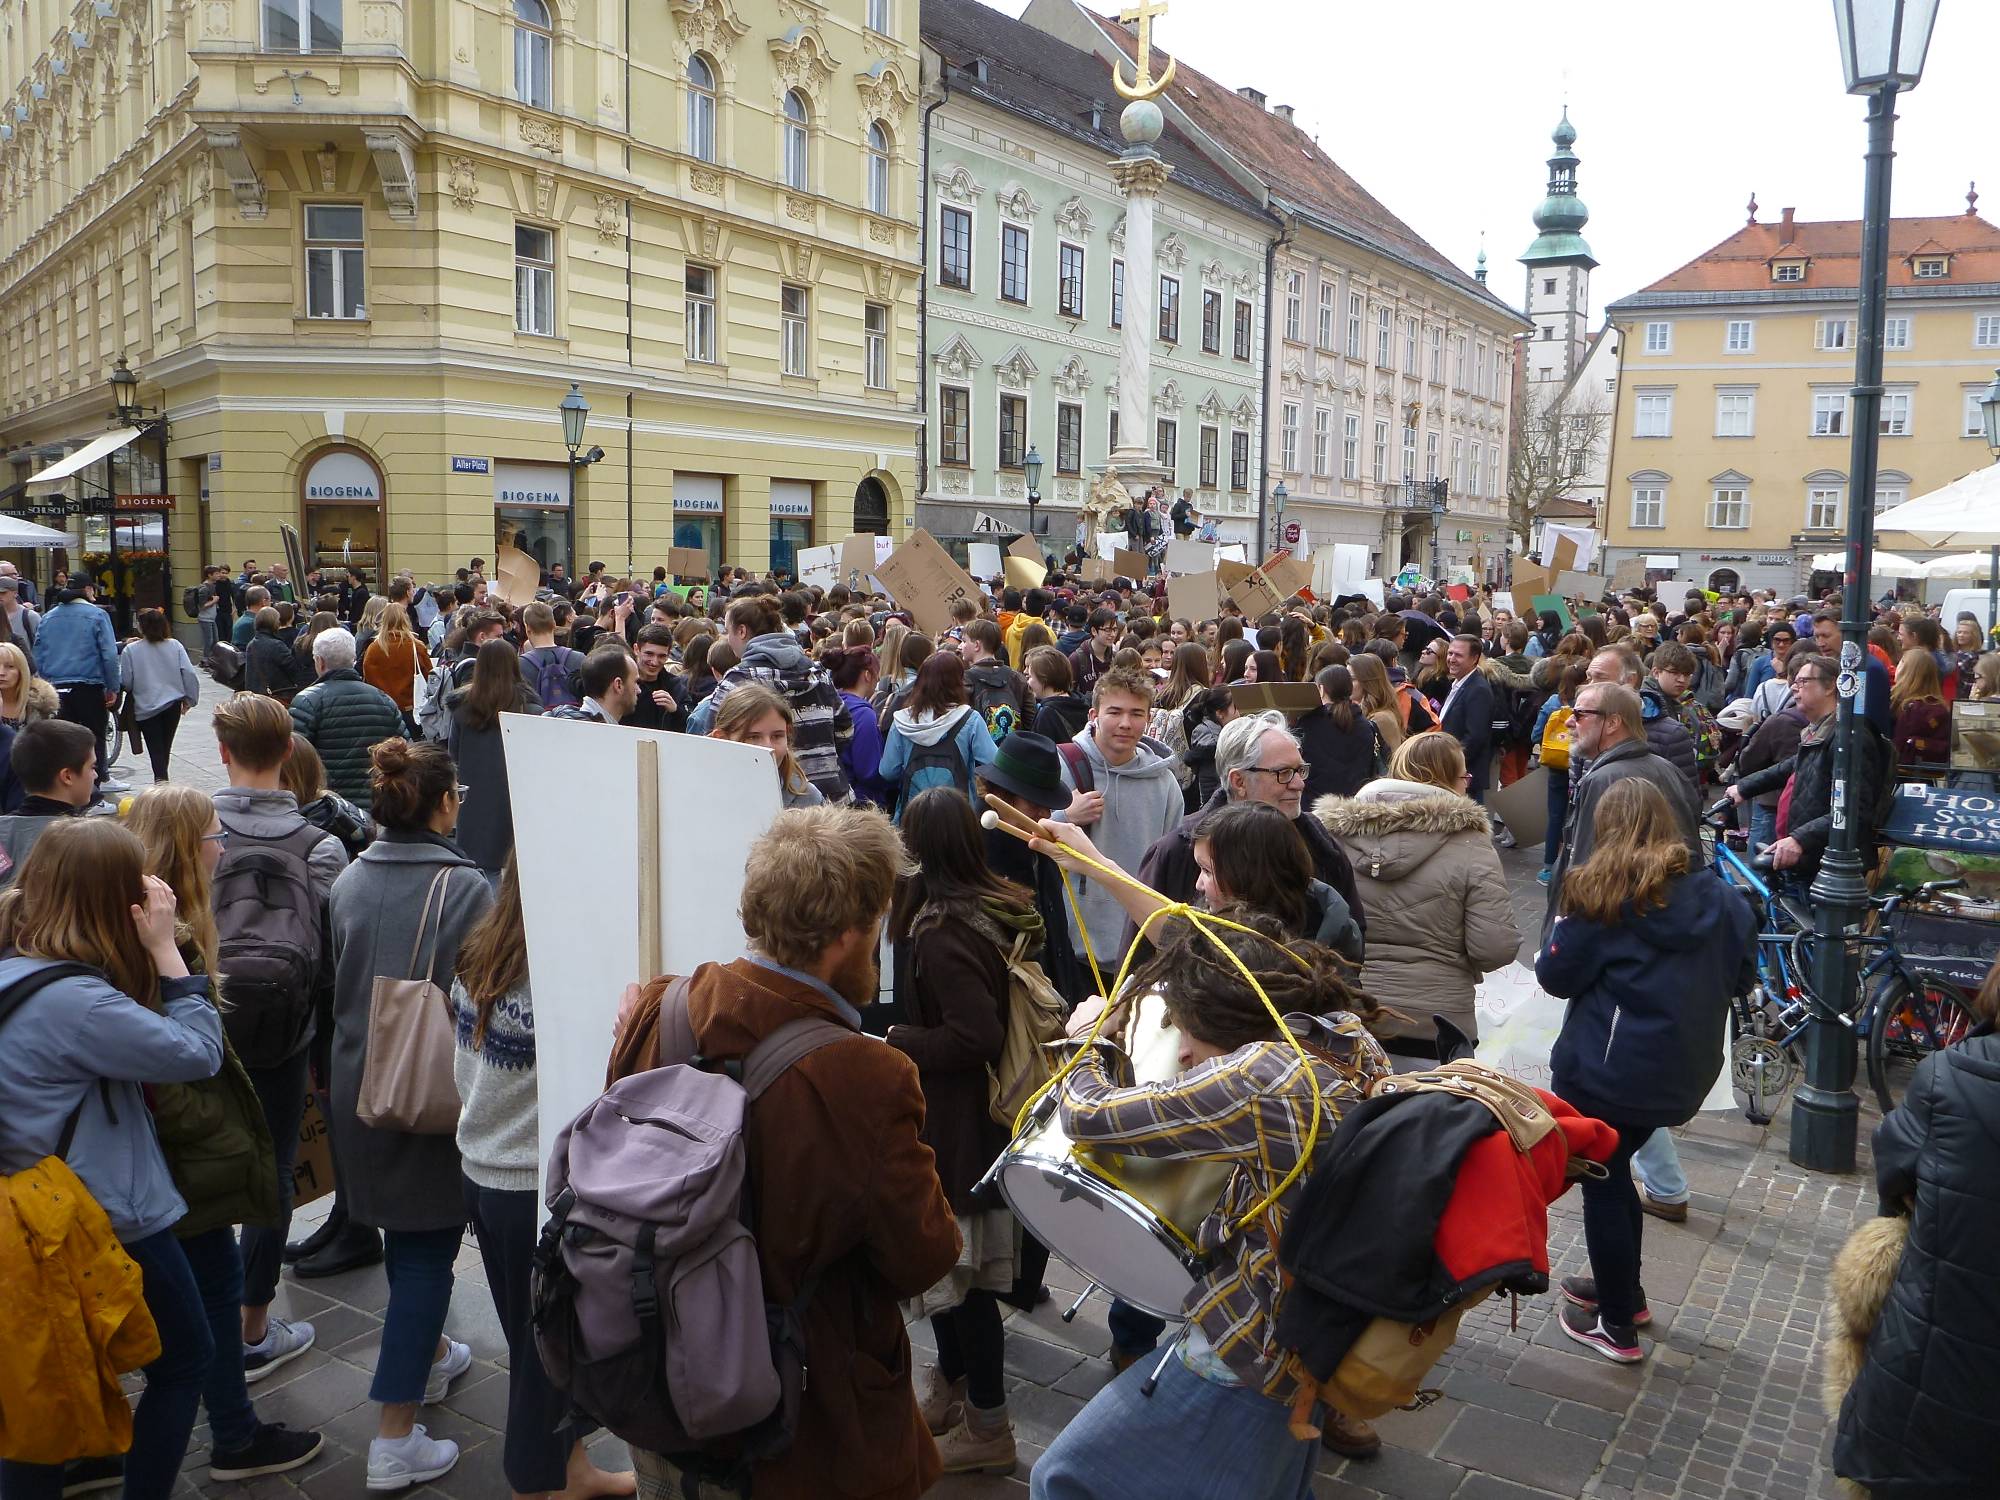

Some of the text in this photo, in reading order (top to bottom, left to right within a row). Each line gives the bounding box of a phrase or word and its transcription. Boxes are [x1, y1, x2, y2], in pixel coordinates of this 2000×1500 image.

[456, 459, 471, 470] Alter
[310, 486, 373, 497] BIOGENA
[502, 491, 560, 502] BIOGENA
[673, 499, 719, 510] BIOGENA
[876, 541, 890, 549] but
[1922, 792, 2000, 813] HO
